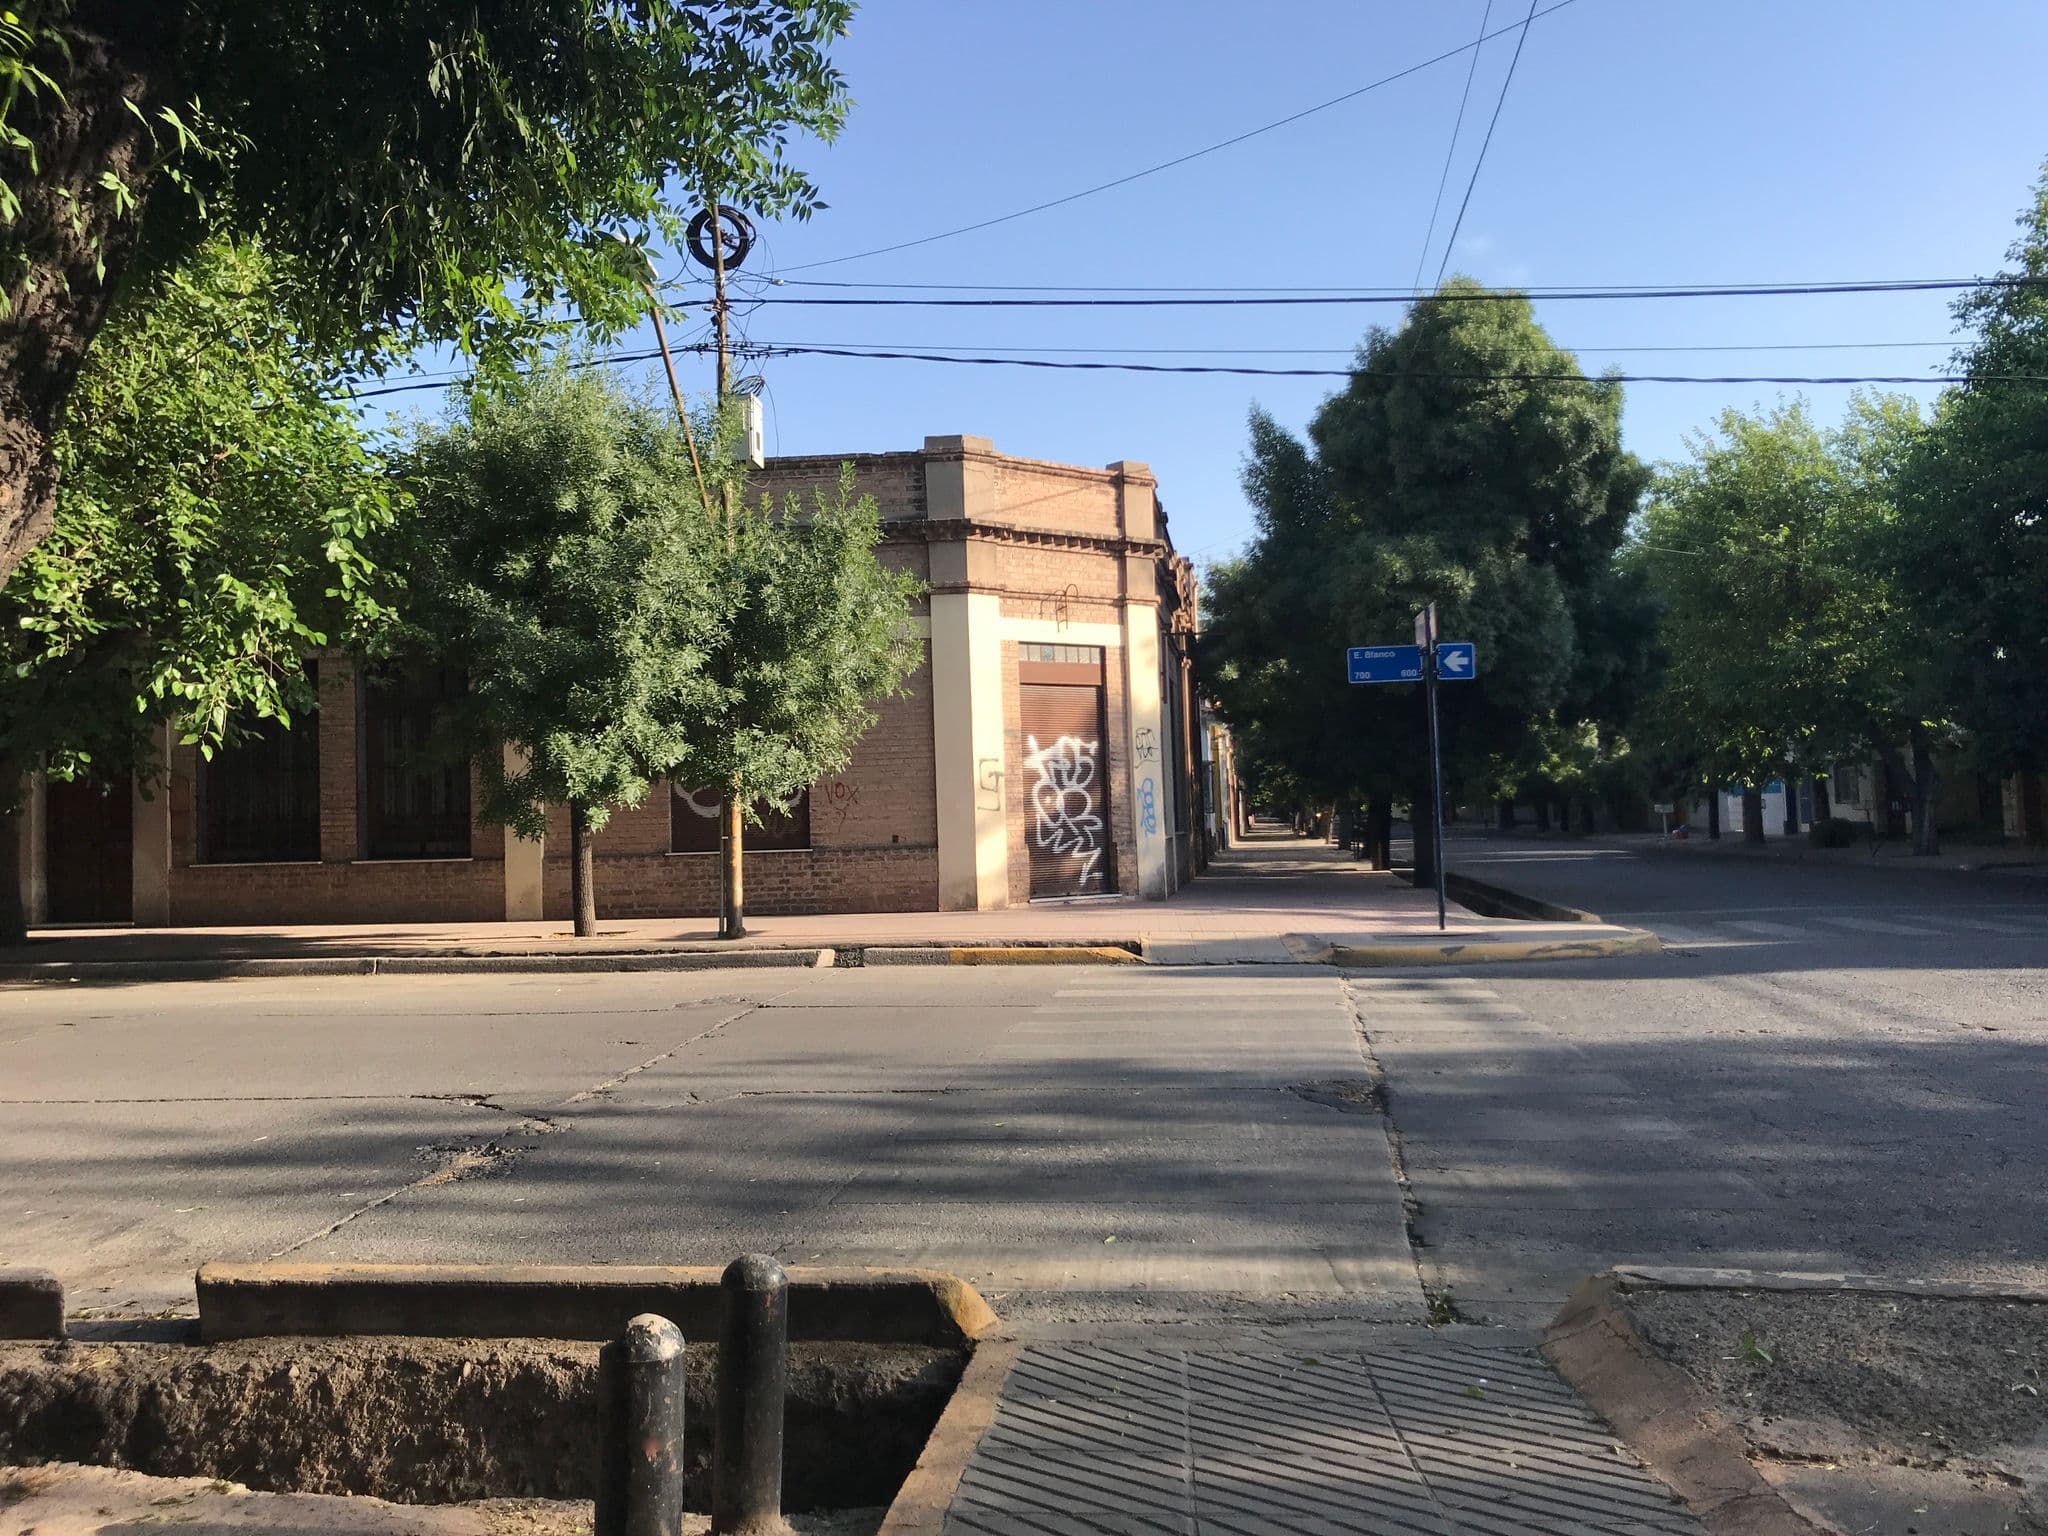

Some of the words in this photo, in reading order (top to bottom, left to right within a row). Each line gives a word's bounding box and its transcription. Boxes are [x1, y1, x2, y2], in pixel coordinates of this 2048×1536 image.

[1353, 651, 1363, 659] E.
[1364, 650, 1396, 659] Blanco
[1353, 671, 1370, 679] 700
